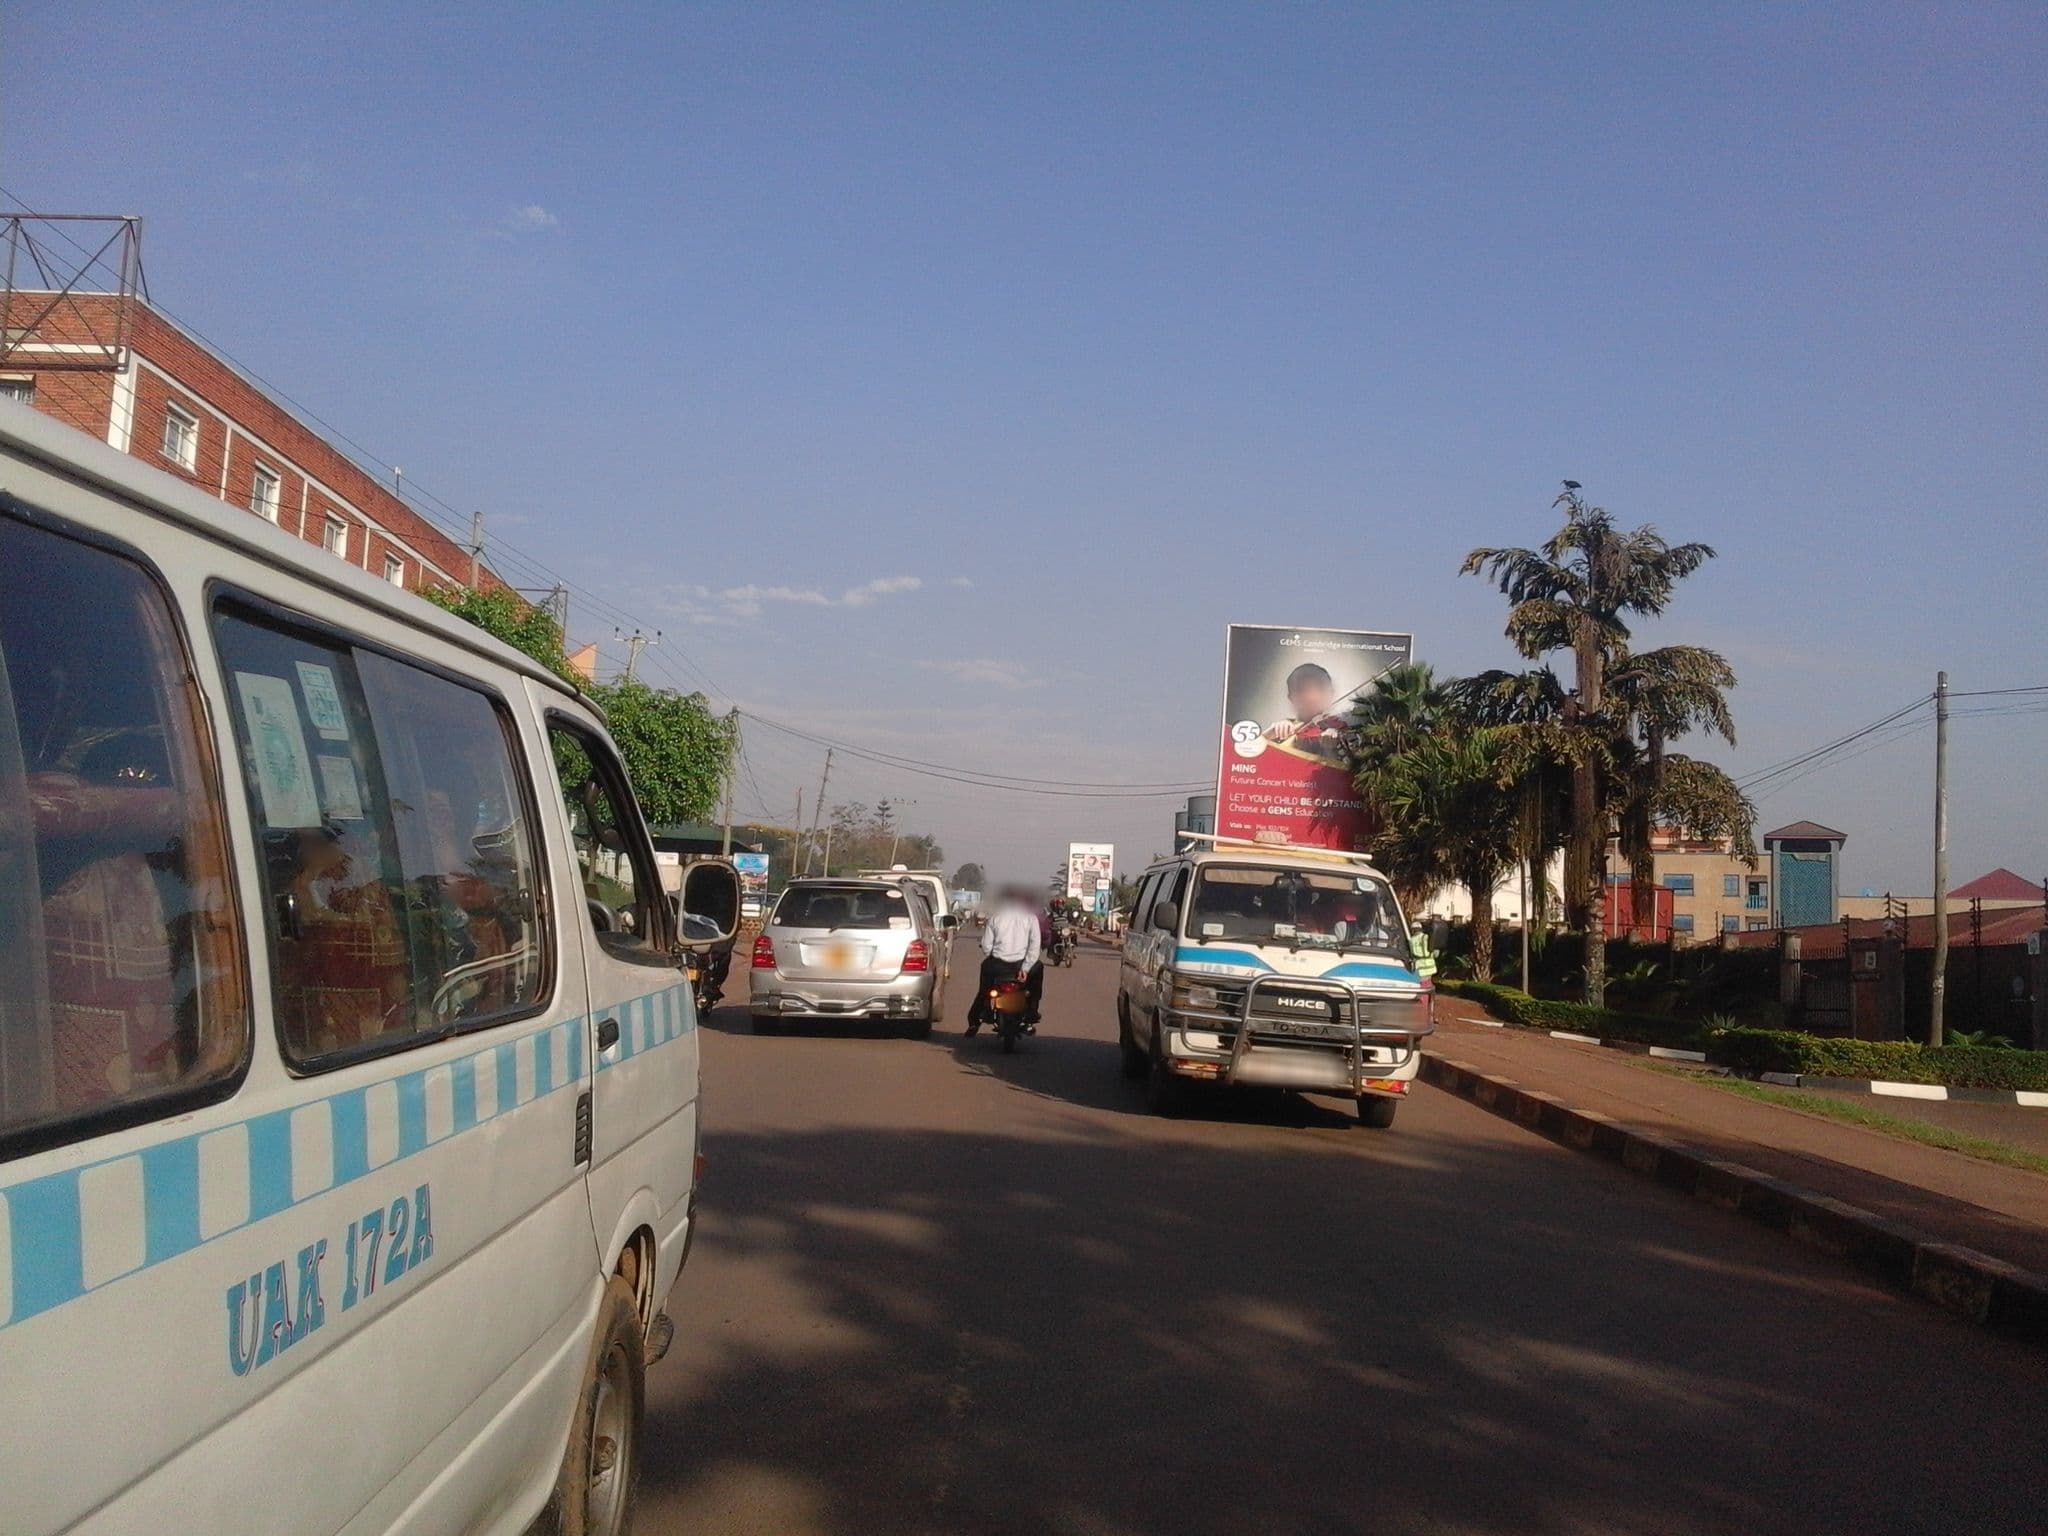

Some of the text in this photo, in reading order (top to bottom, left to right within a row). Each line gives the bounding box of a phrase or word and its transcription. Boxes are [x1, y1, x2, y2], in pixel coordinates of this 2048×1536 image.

[1279, 638, 1301, 647] GEMS
[1303, 639, 1341, 650] Cambridge
[1383, 644, 1406, 652] School
[1236, 725, 1258, 742] 55
[1231, 763, 1257, 774] MING
[1230, 776, 1256, 785] Future
[1256, 777, 1287, 787] Concert
[1229, 793, 1245, 802] LET
[1247, 794, 1272, 804] YOUR
[1273, 795, 1297, 806] CHILD
[1299, 797, 1312, 807] BE
[1229, 803, 1258, 814] Choose
[1267, 806, 1293, 816] GEMS
[1278, 997, 1326, 1010] HIACE
[1272, 1022, 1330, 1036] TOYOTA
[226, 1183, 434, 1377] UAK 172A
